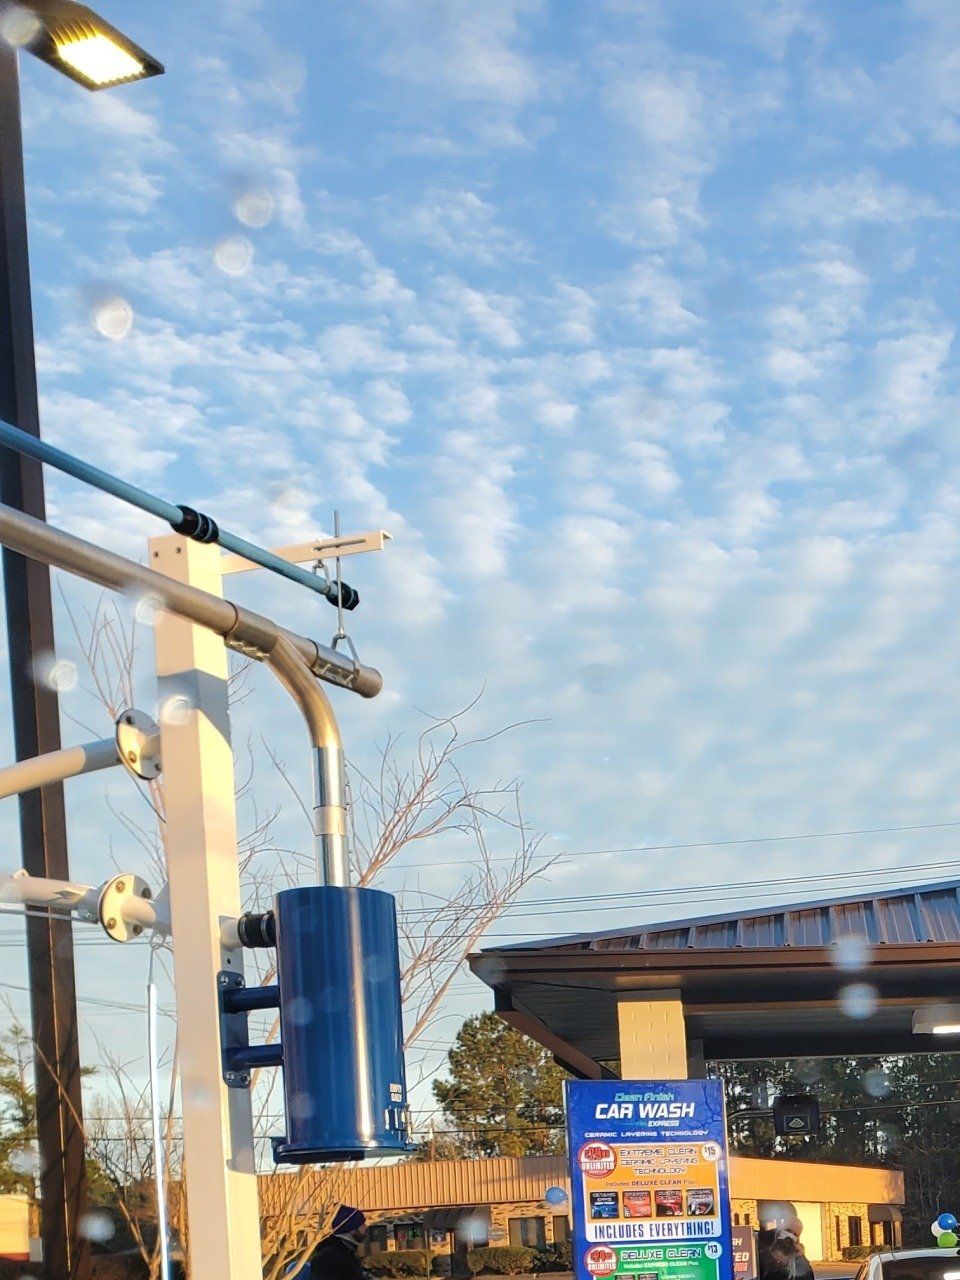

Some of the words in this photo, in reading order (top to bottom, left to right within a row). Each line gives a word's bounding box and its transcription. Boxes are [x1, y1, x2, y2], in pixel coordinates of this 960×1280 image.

[595, 1103, 633, 1119] CAR
[639, 1102, 695, 1119] WASH
[620, 1148, 664, 1157] EXTREME
[668, 1147, 698, 1156] CLEAN
[594, 1223, 644, 1239] INCLUDES
[650, 1221, 715, 1238] EVERYTHING!
[621, 1249, 663, 1260] DELUXE
[667, 1248, 702, 1259] CLEAN
